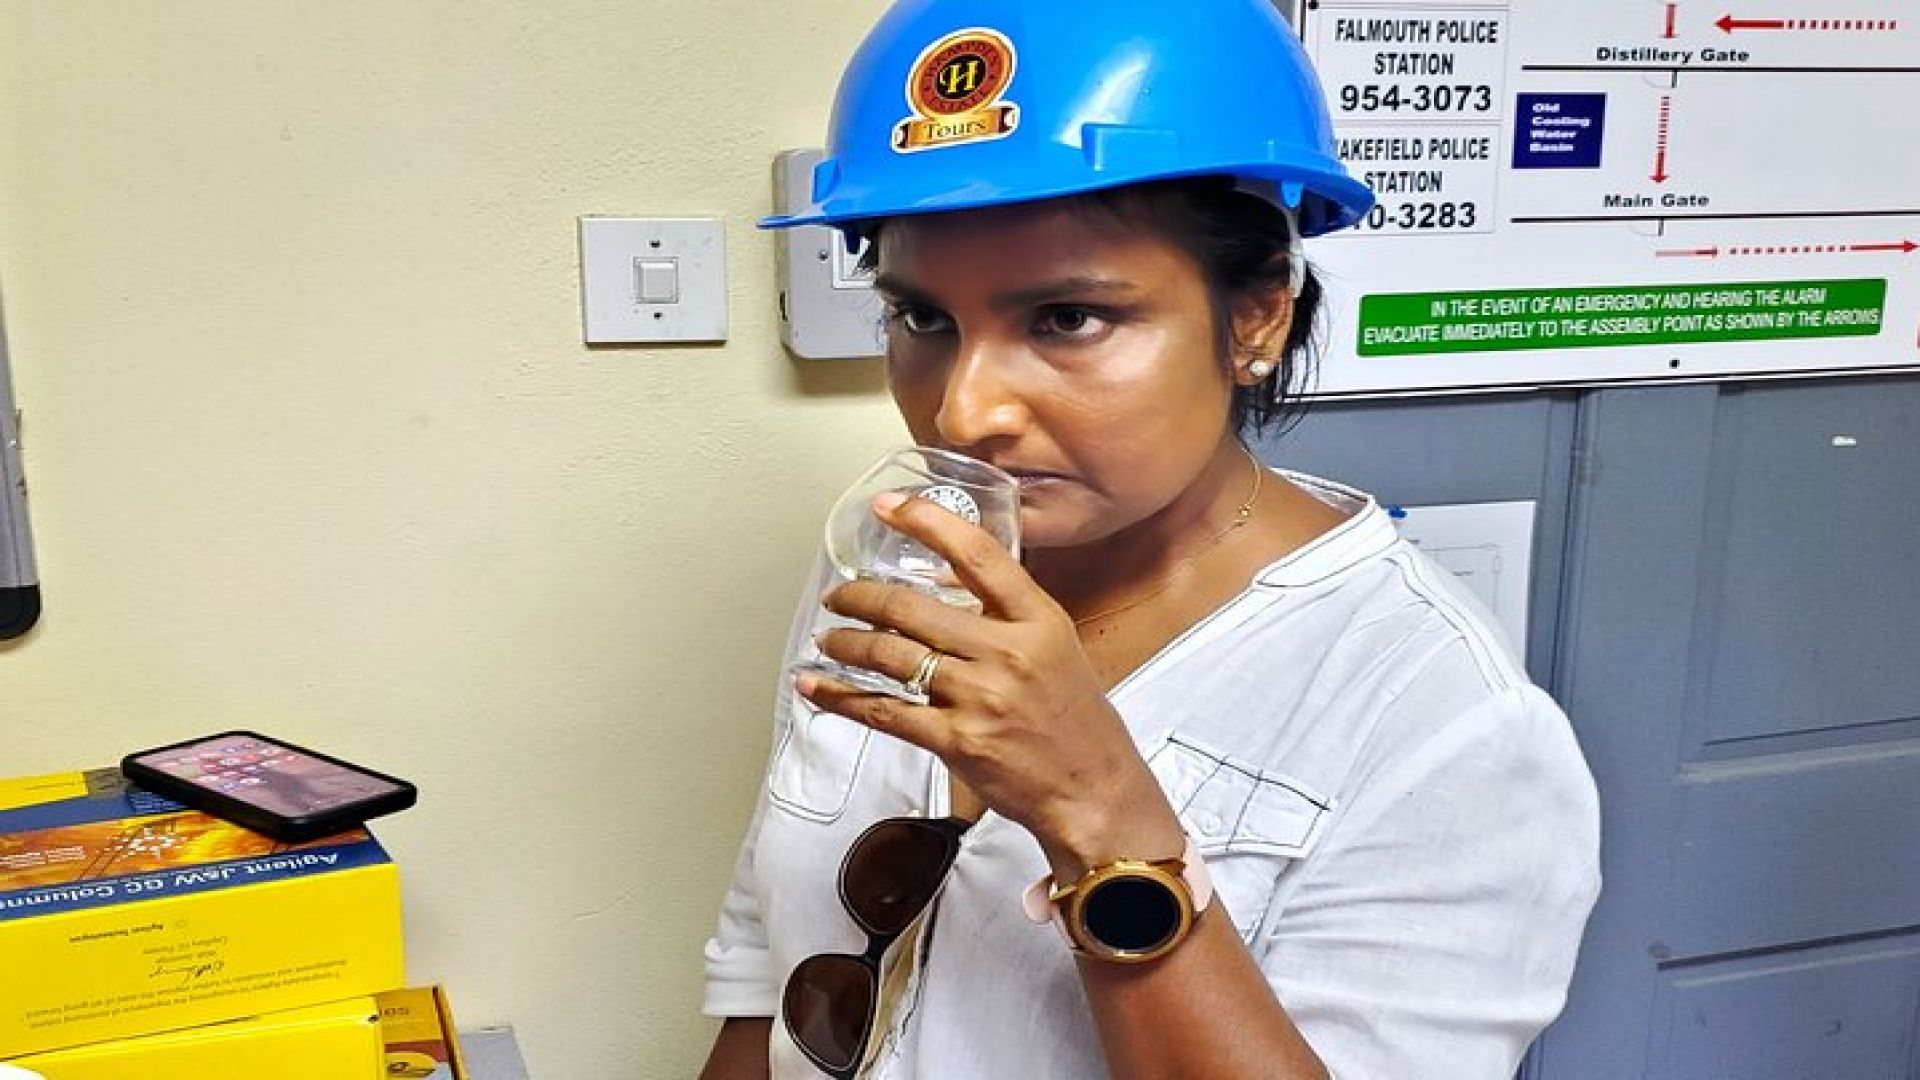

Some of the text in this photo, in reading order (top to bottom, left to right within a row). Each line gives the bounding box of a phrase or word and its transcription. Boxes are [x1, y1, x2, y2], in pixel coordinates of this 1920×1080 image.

[1335, 19, 1498, 43] FALMOUTH POLICE
[1374, 53, 1454, 75] STATION
[1596, 47, 1750, 64] Distillery Gate
[1340, 84, 1492, 111] 954-3073
[1532, 103, 1560, 113] Old
[924, 120, 987, 138] Tours
[1532, 116, 1591, 128] Cooling
[1530, 130, 1577, 139] Water
[1335, 137, 1490, 160] AKEFIELD POLICE
[1529, 143, 1574, 153] Basin
[1364, 170, 1443, 193] STATION
[1603, 193, 1710, 208] Main Gate
[1354, 202, 1476, 230] 0-3283
[1431, 287, 1827, 317] IN THE EVENT OF AN EMERGENCY AND HEARING THE ALARM
[1363, 307, 1880, 345] EVACUATE IMMEDIATELY TO THE ASSEMBLY POINT AS SHOWN BY THE ARROWS
[243, 853, 337, 874] Agilent
[125, 878, 164, 895] GC
